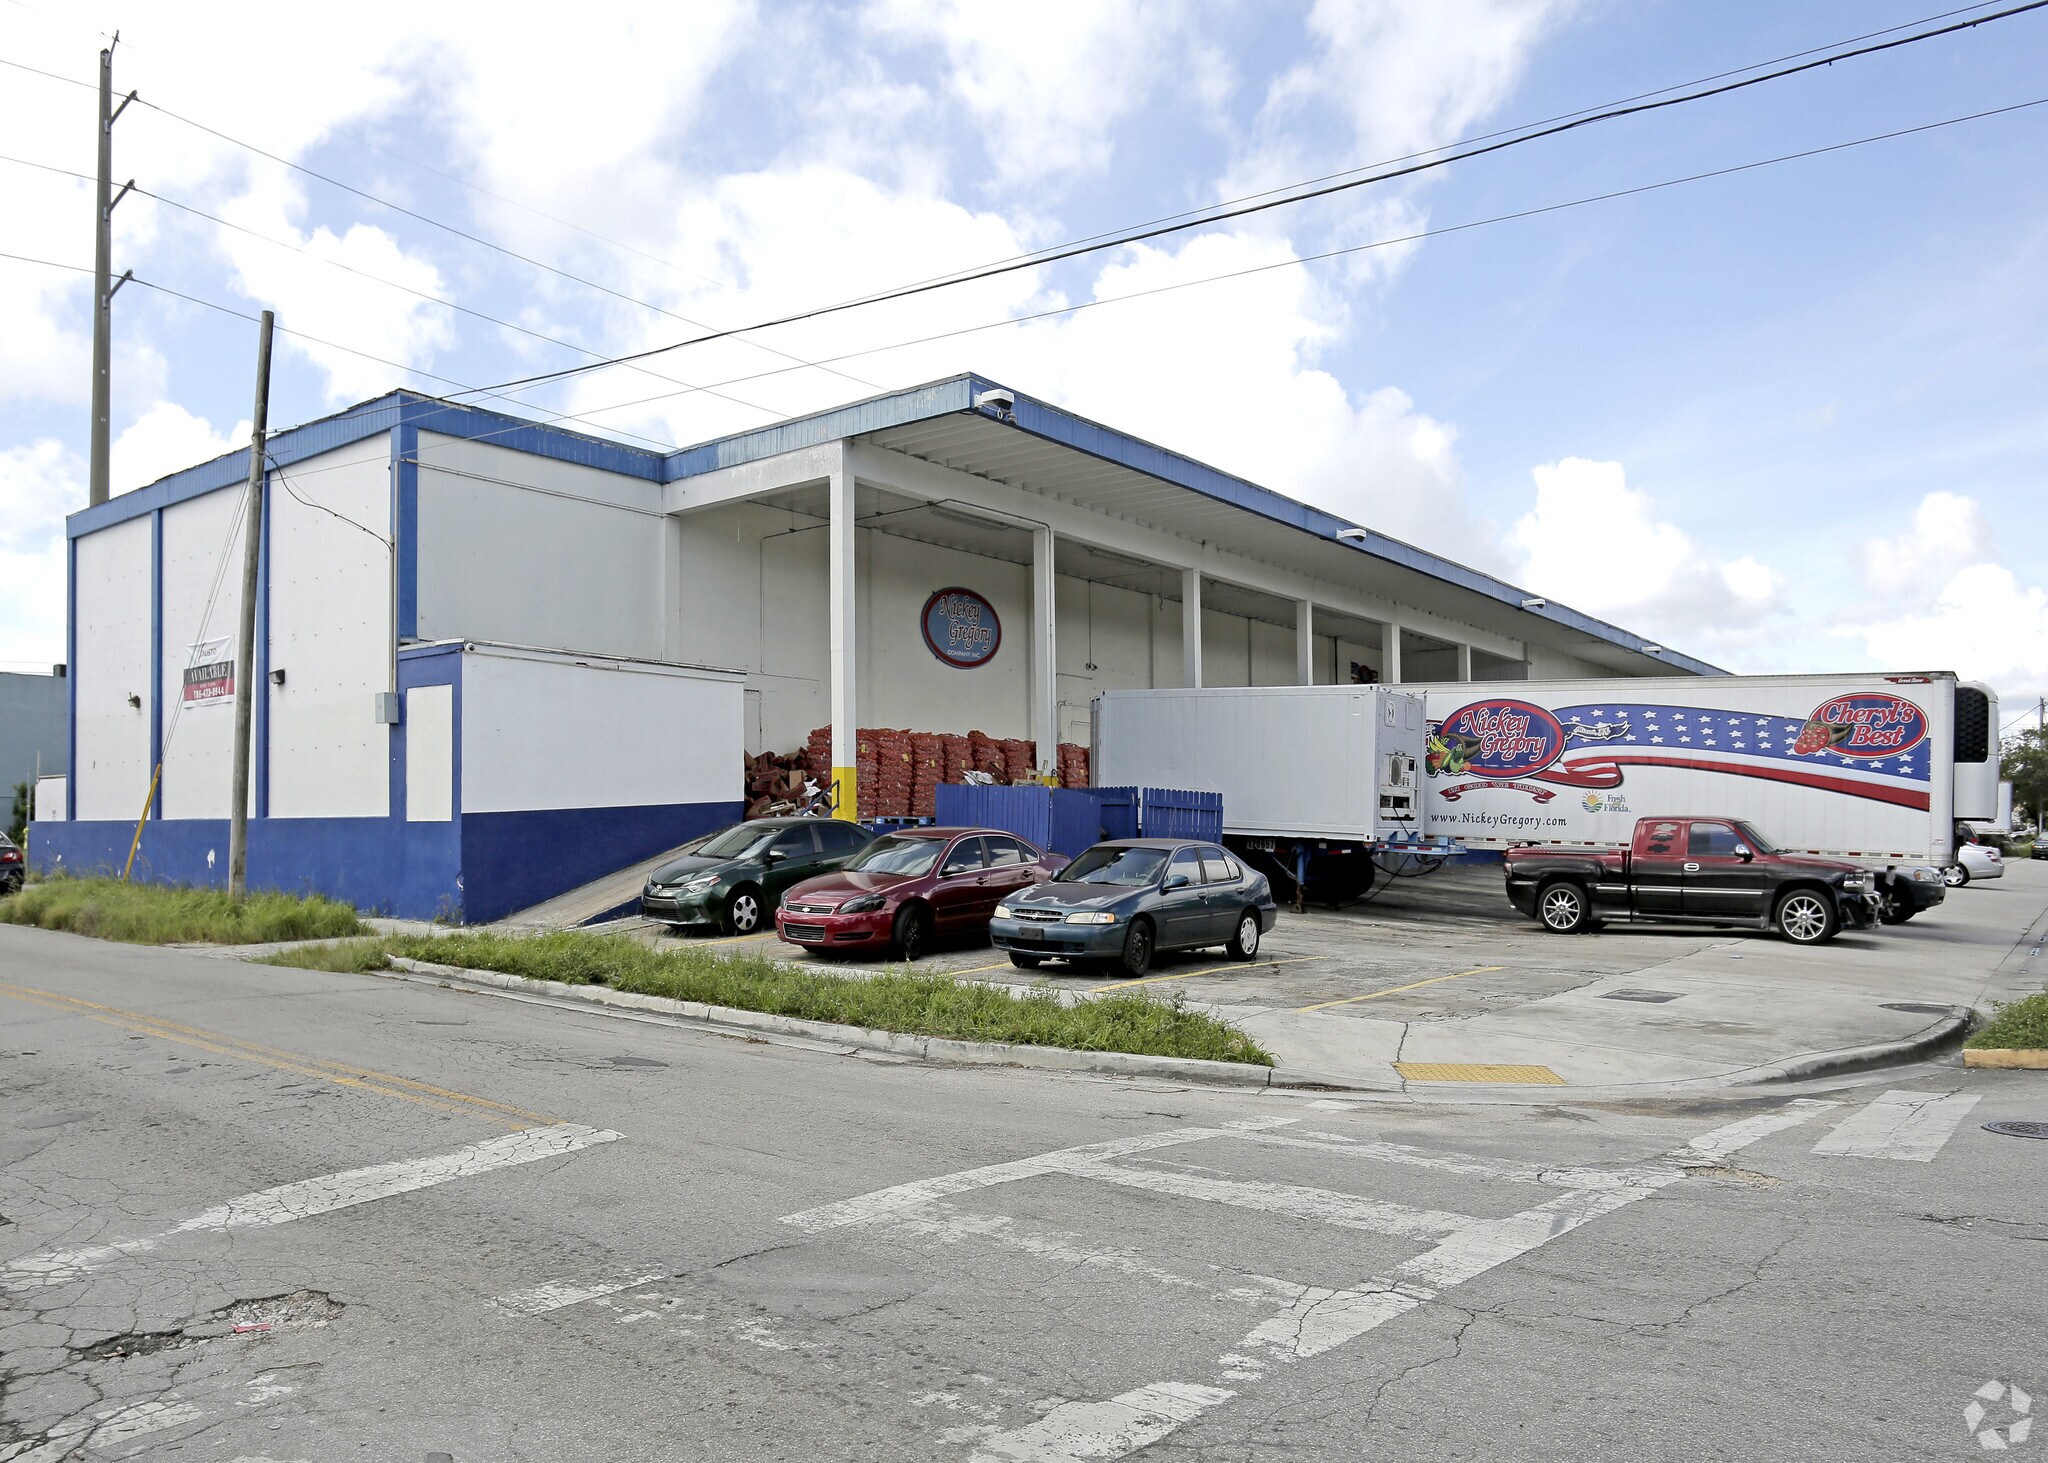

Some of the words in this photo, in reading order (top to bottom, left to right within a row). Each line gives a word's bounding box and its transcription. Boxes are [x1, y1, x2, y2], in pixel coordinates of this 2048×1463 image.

[939, 594, 981, 627] Nickey
[949, 620, 992, 651] Gregory
[947, 649, 971, 657] COMPANY
[191, 663, 227, 682] AVAILABLE
[1459, 706, 1531, 738] Nickey
[1821, 700, 1916, 728] Cheryl's
[1479, 732, 1547, 761] Gregory
[1848, 725, 1905, 746] Best
[1607, 794, 1626, 803] Fresh
[1431, 812, 1567, 829] www.NickeyGregory.com
